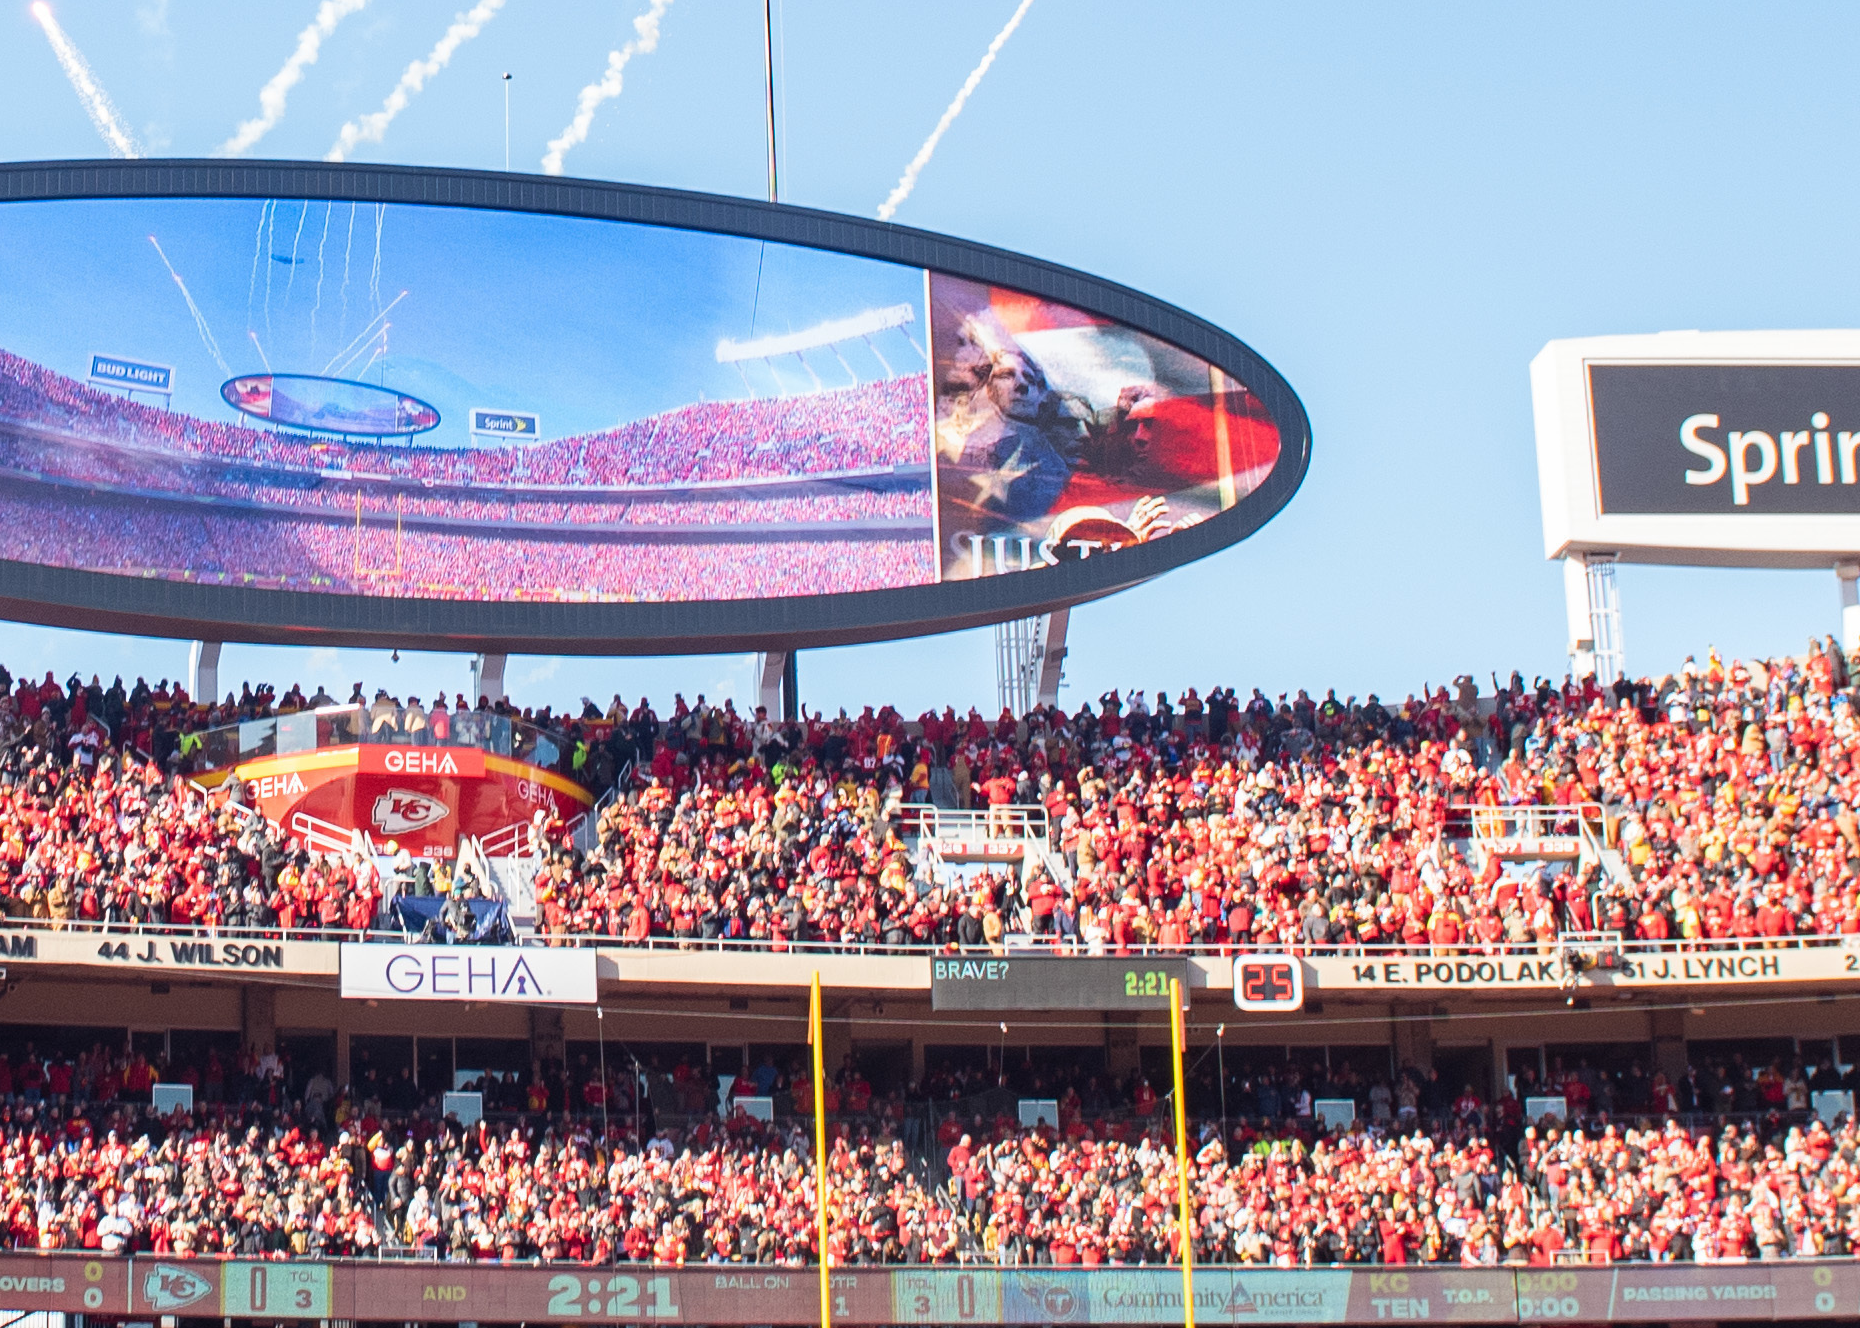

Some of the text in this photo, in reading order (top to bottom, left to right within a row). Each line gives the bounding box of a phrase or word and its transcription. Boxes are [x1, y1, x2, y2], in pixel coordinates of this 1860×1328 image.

[96, 361, 167, 384] BUD LIGHT
[484, 416, 513, 431] Sprint
[385, 752, 458, 774] GEHA
[246, 772, 304, 800] GEHA
[97, 940, 283, 968] 44 J. WILSON
[386, 954, 542, 996] GEHA
[935, 961, 1009, 982] BRAVE?
[1351, 959, 1555, 983] 14 E. PODOLAK
[1653, 957, 1676, 980] J.
[1683, 955, 1780, 978] LYNCH
[1125, 972, 1169, 996] 2:21
[1246, 964, 1293, 1000] 25
[84, 1260, 103, 1283] 0
[291, 1271, 318, 1284] TOL
[1813, 1267, 1832, 1287] 0
[715, 1275, 790, 1290] BALL ON
[1370, 1273, 1409, 1293] KC
[1514, 1273, 1578, 1292] 0:00
[83, 1287, 103, 1309] 0
[295, 1289, 313, 1309] 3
[422, 1285, 467, 1302] AND
[548, 1273, 679, 1318] 2:21
[1443, 1288, 1493, 1304] T.O.P.
[1623, 1284, 1777, 1303] PASSING YARDS
[1814, 1291, 1835, 1313] 0
[835, 1296, 850, 1317] 1
[913, 1296, 931, 1315] 3
[1371, 1298, 1430, 1319] TEN
[1512, 1296, 1580, 1317] 0:00
